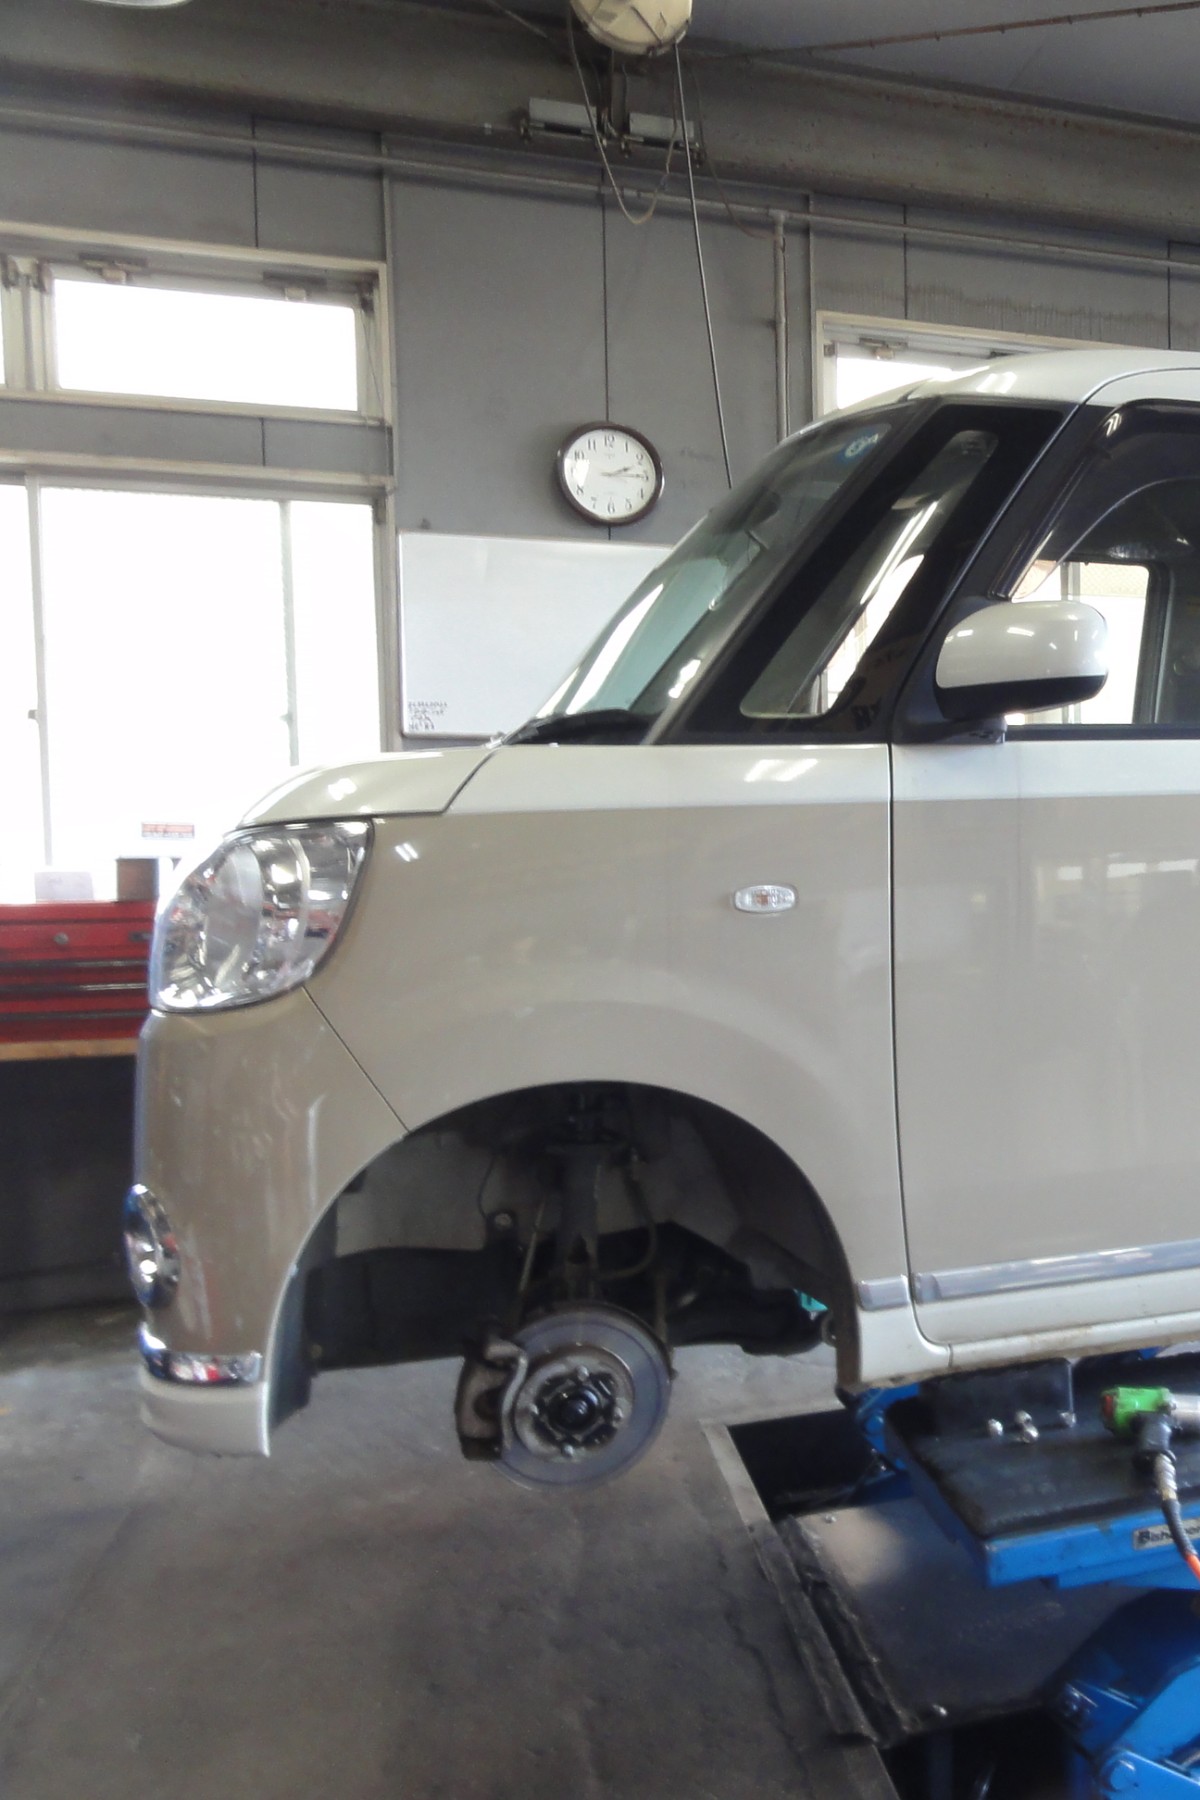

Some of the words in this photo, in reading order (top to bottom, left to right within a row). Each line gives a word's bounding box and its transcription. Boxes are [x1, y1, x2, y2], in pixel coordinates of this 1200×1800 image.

[588, 439, 597, 451] 11
[604, 434, 615, 449] 12
[574, 450, 585, 461] 10
[635, 453, 644, 465] 2
[576, 484, 584, 495] 8
[590, 496, 597, 509] 7
[607, 496, 616, 514] 6
[625, 498, 632, 511] 5
